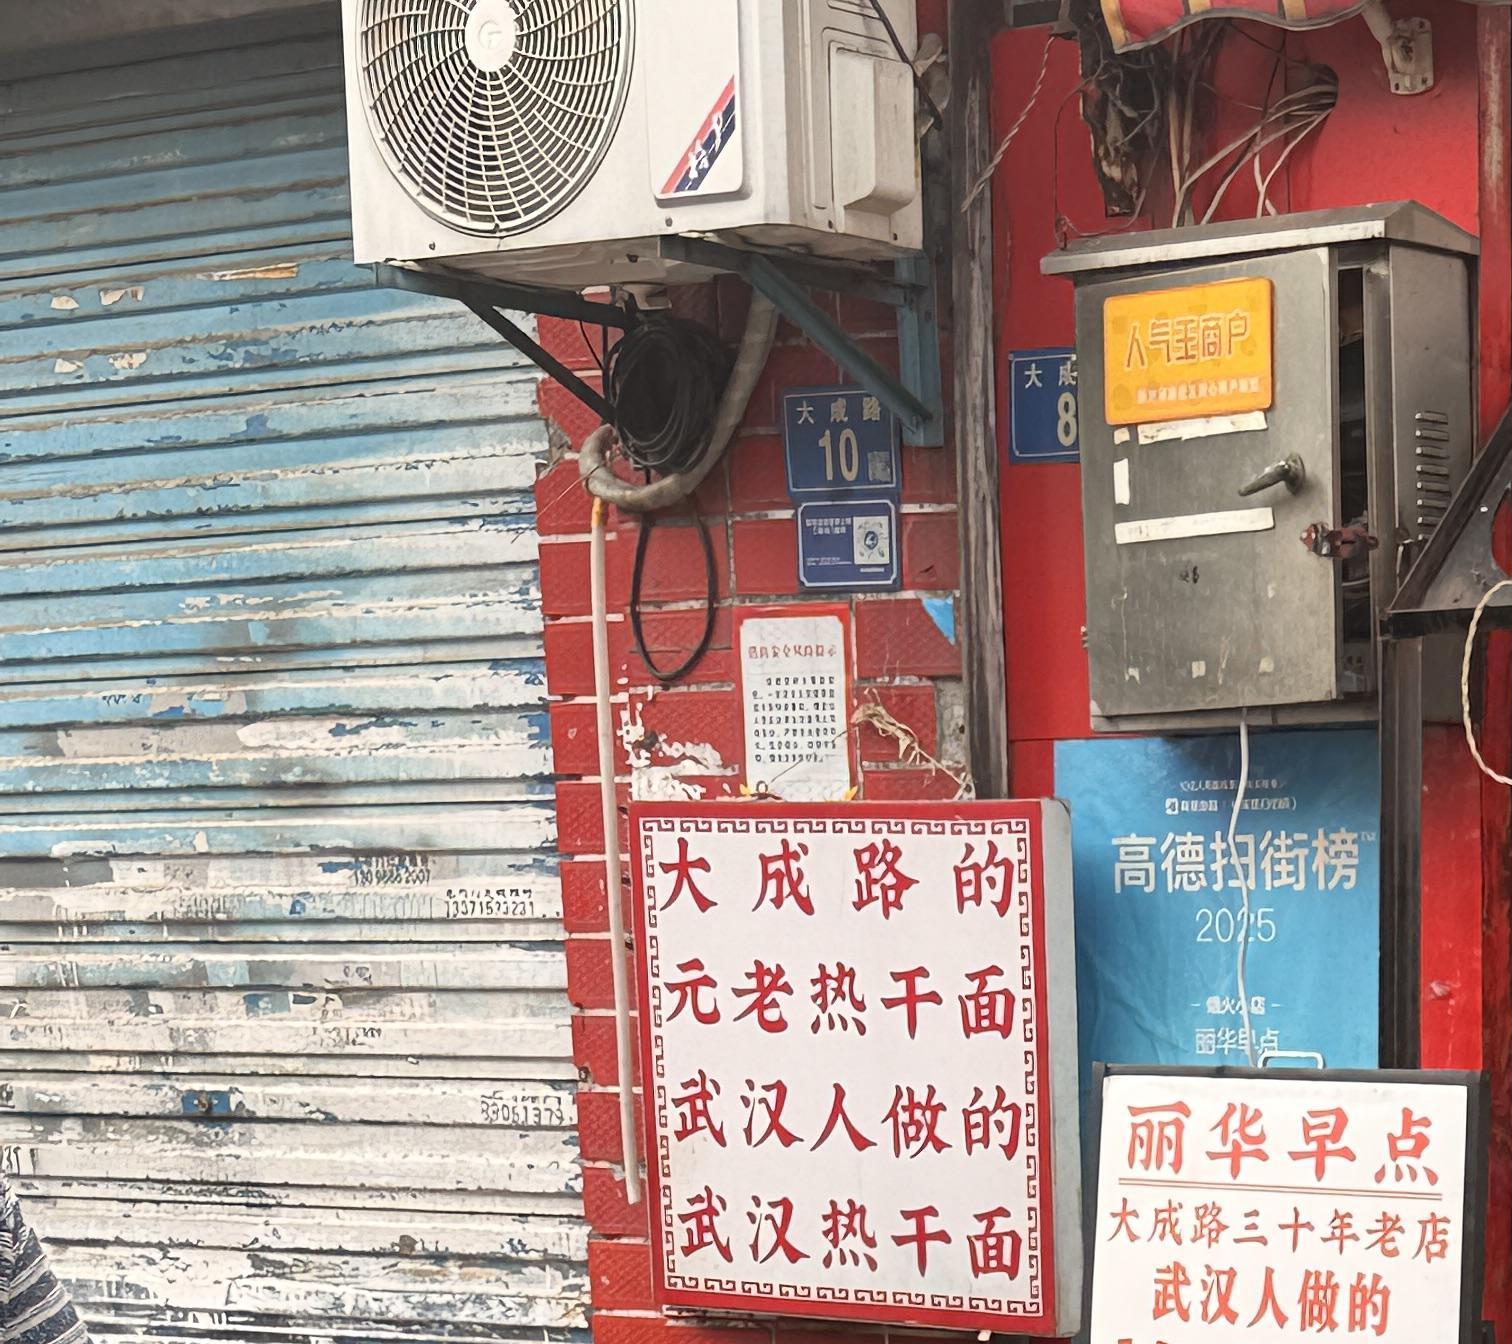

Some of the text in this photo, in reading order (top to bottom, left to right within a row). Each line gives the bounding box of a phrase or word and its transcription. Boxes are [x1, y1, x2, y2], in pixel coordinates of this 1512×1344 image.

[796, 397, 882, 426] 大成路
[1057, 392, 1077, 448] 8
[818, 428, 859, 481] 10
[659, 838, 1015, 921] 大成路的
[1111, 827, 1360, 893] 高德扫街榜
[1195, 907, 1277, 943] 2025
[664, 958, 1016, 1041] 元老热干面
[671, 1070, 1023, 1162] 武汉人做的
[1127, 1101, 1440, 1187] 丽华早点
[677, 1193, 1023, 1282] 武汉热干面
[1106, 1197, 1452, 1264] 大成路三十年老店
[1152, 1262, 1391, 1337] 武汉人做的
